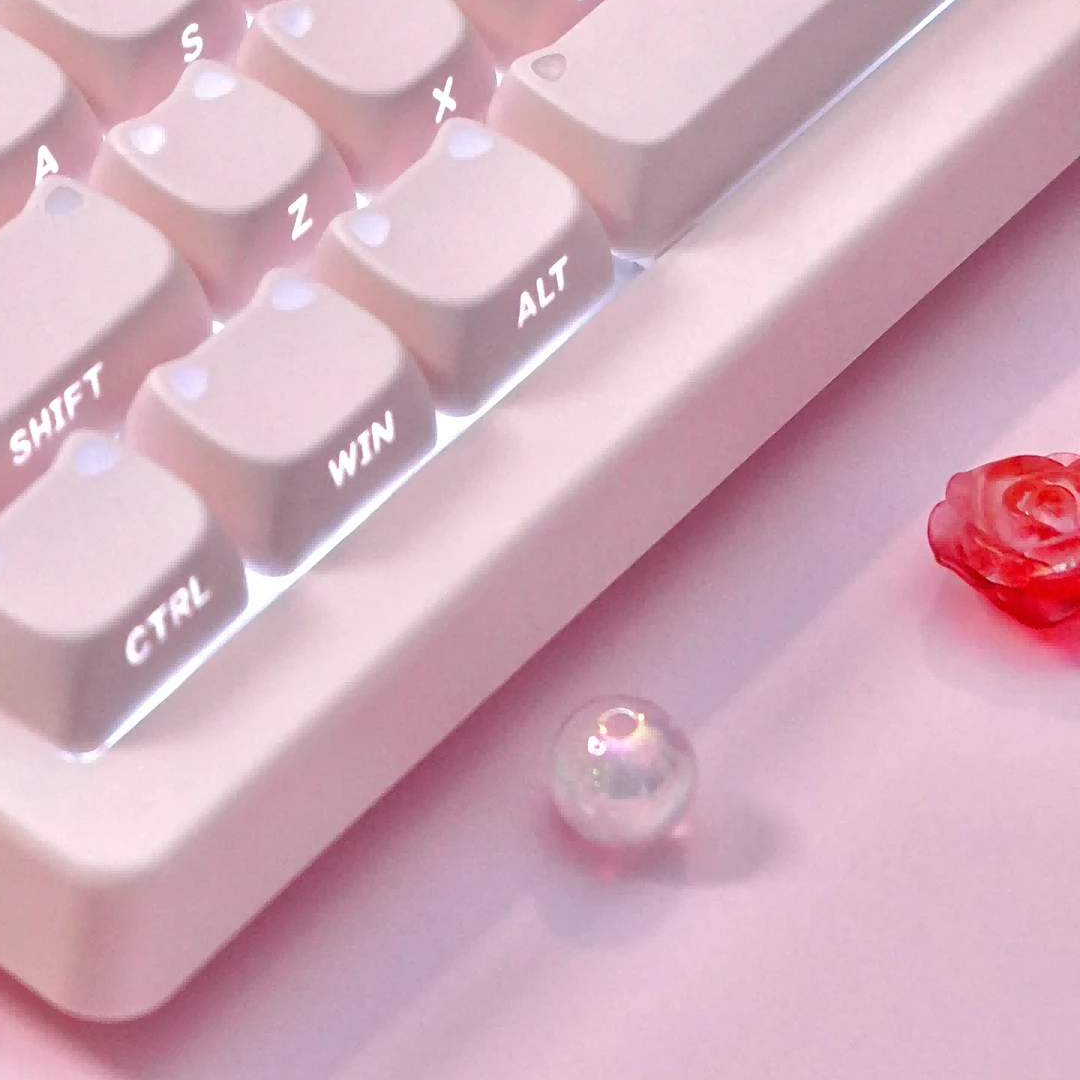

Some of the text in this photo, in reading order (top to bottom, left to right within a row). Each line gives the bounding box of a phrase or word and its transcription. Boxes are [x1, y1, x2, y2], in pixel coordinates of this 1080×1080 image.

[180, 23, 204, 63] S
[431, 76, 458, 124] X
[33, 144, 60, 186] A
[287, 193, 313, 241] Z
[516, 255, 570, 329] ALT
[8, 362, 105, 467] SHIFT
[327, 410, 397, 488] WIN
[123, 575, 212, 668] CTRL
